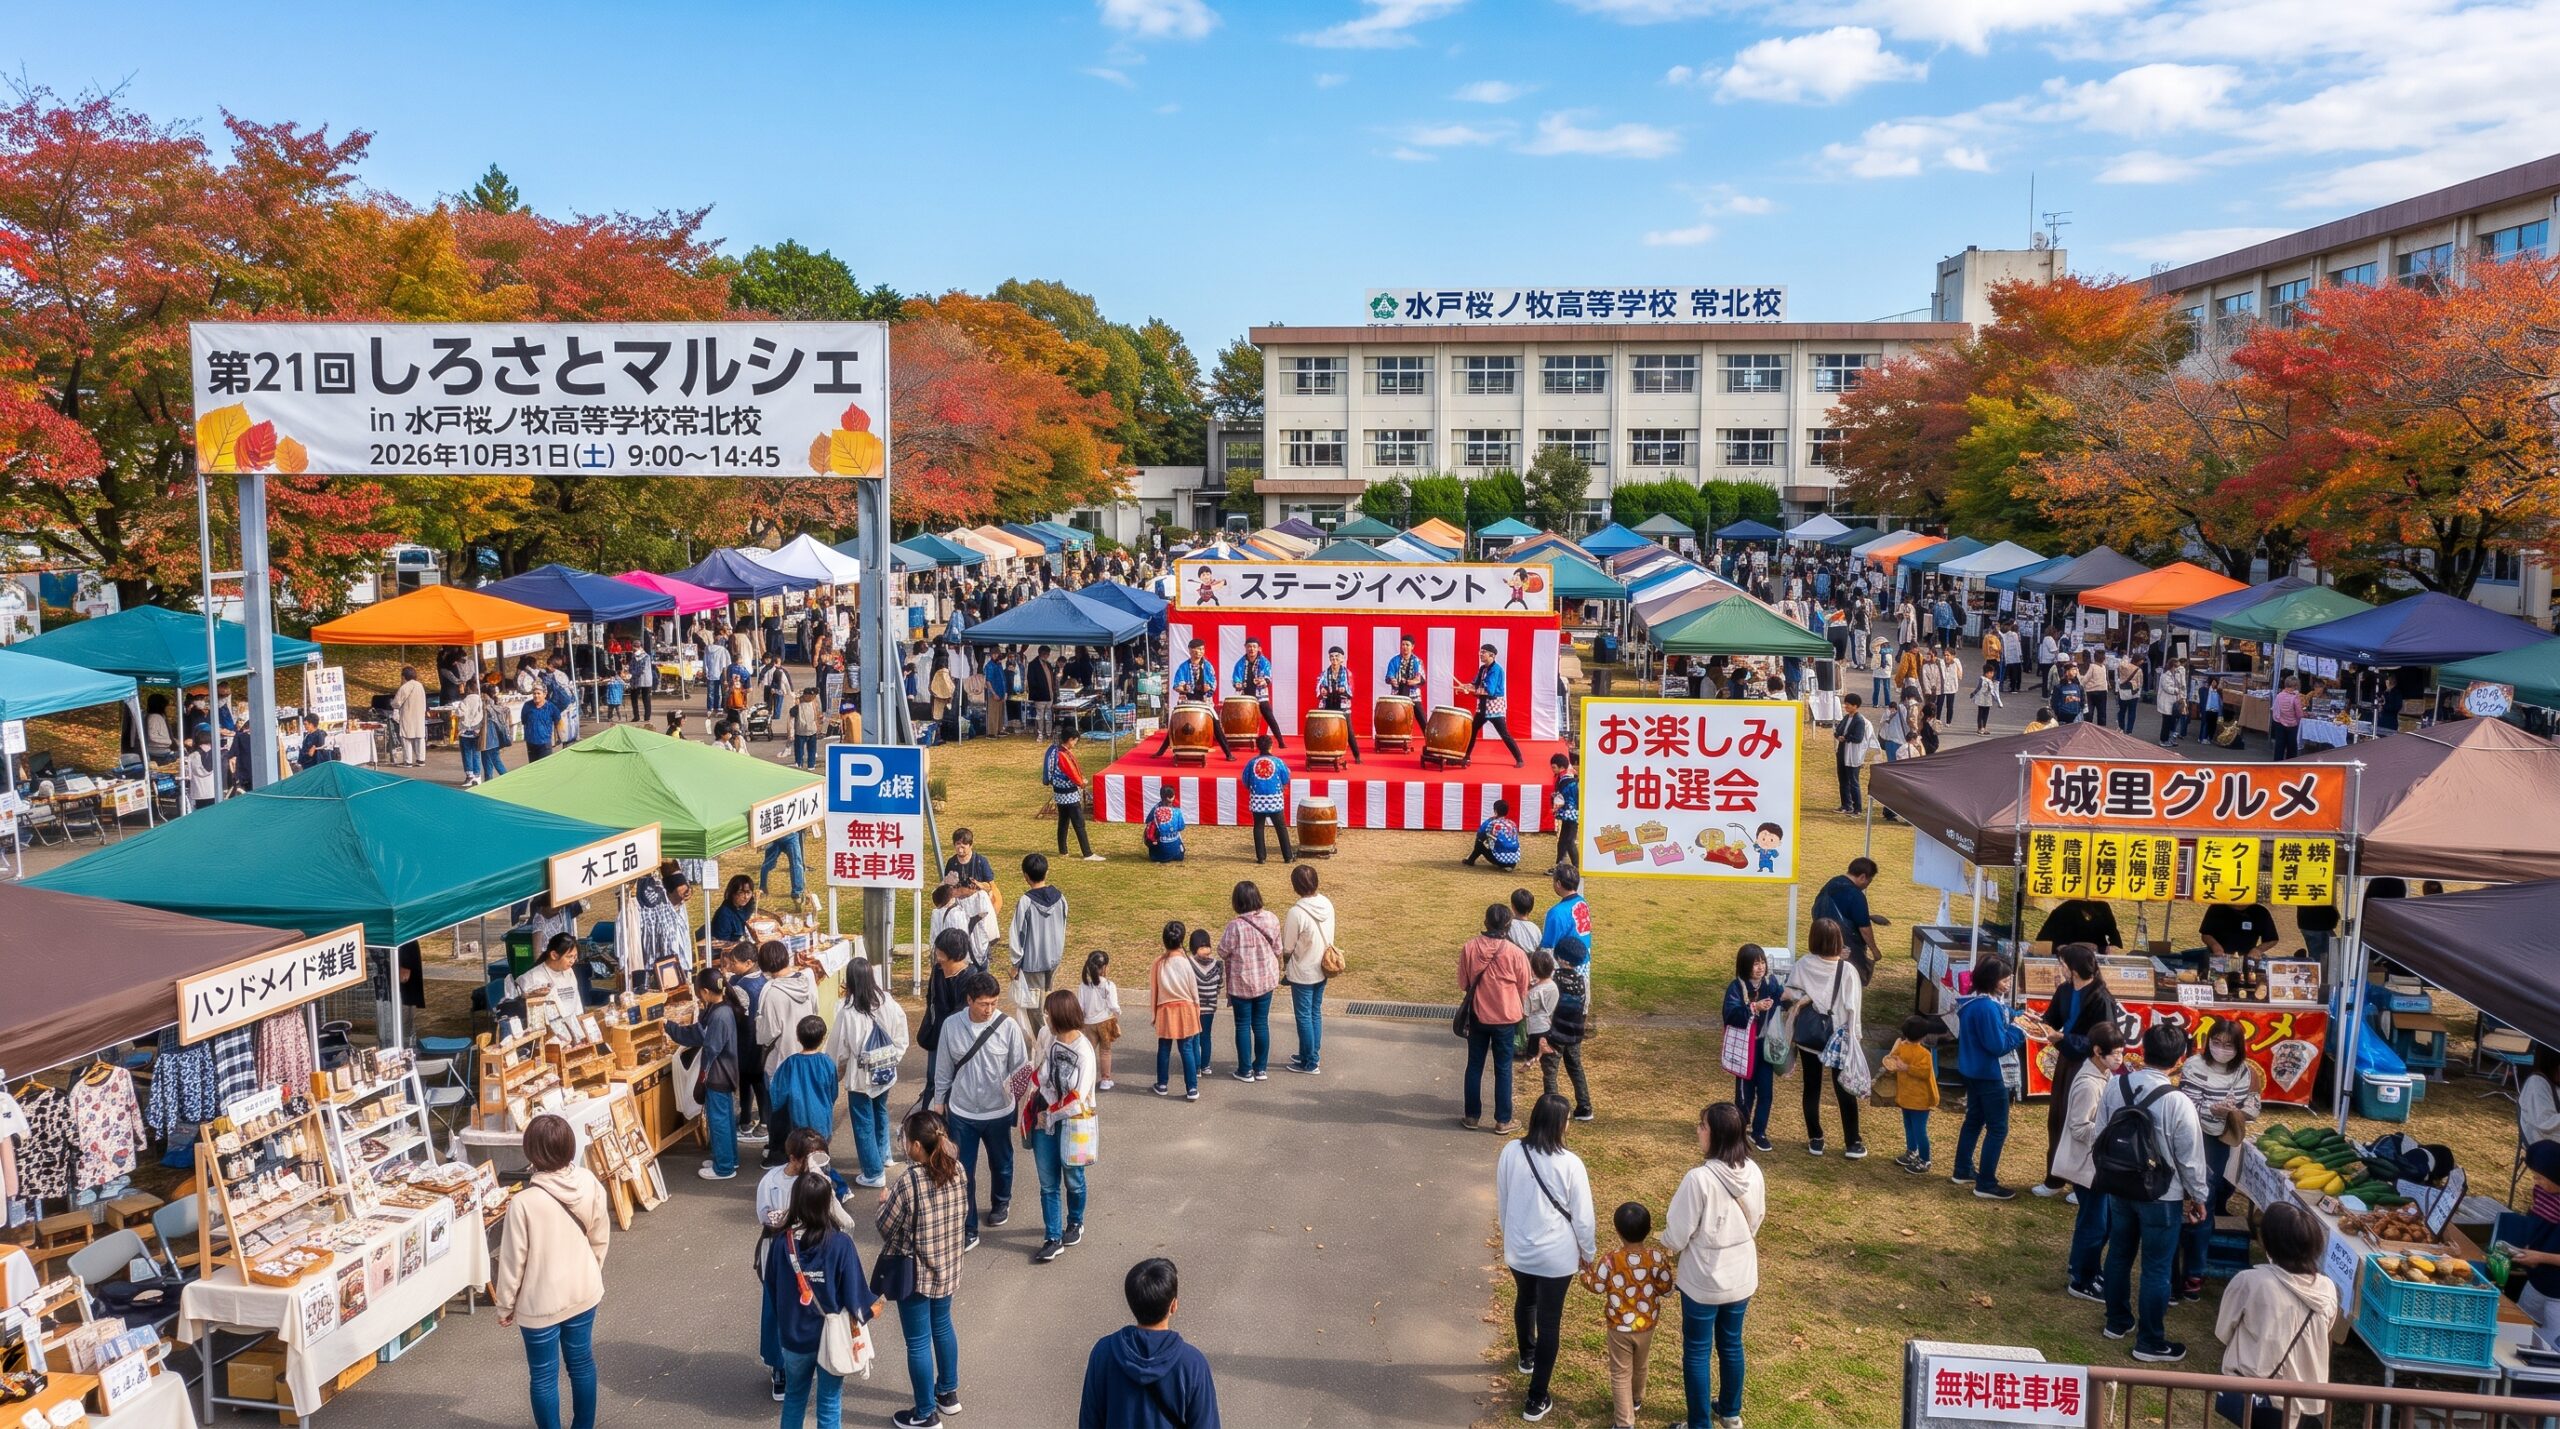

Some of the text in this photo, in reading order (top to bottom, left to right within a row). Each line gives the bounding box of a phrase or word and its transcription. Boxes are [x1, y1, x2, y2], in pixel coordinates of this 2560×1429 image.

[1405, 288, 1782, 319] 水戸桜ノ牧高等学校 常北校
[207, 336, 862, 397] 第21回 しろさとマルシェ
[371, 405, 762, 436] in 水戸桜ノ牧高等学校常北校
[371, 443, 615, 469] 2026年10月31日(土)
[1240, 571, 1486, 603] ステージイベント
[1598, 714, 1782, 760] お楽しみ
[840, 753, 884, 801] P
[1616, 766, 1759, 813] 抽選会
[2048, 766, 2320, 819] 城里グルメ
[847, 820, 904, 848] 無料
[582, 843, 638, 885] 木工品
[834, 852, 915, 880] 駐車場
[191, 941, 357, 1023] ハンドメイド雑貨
[1935, 1368, 2081, 1416] 無料駐車場
